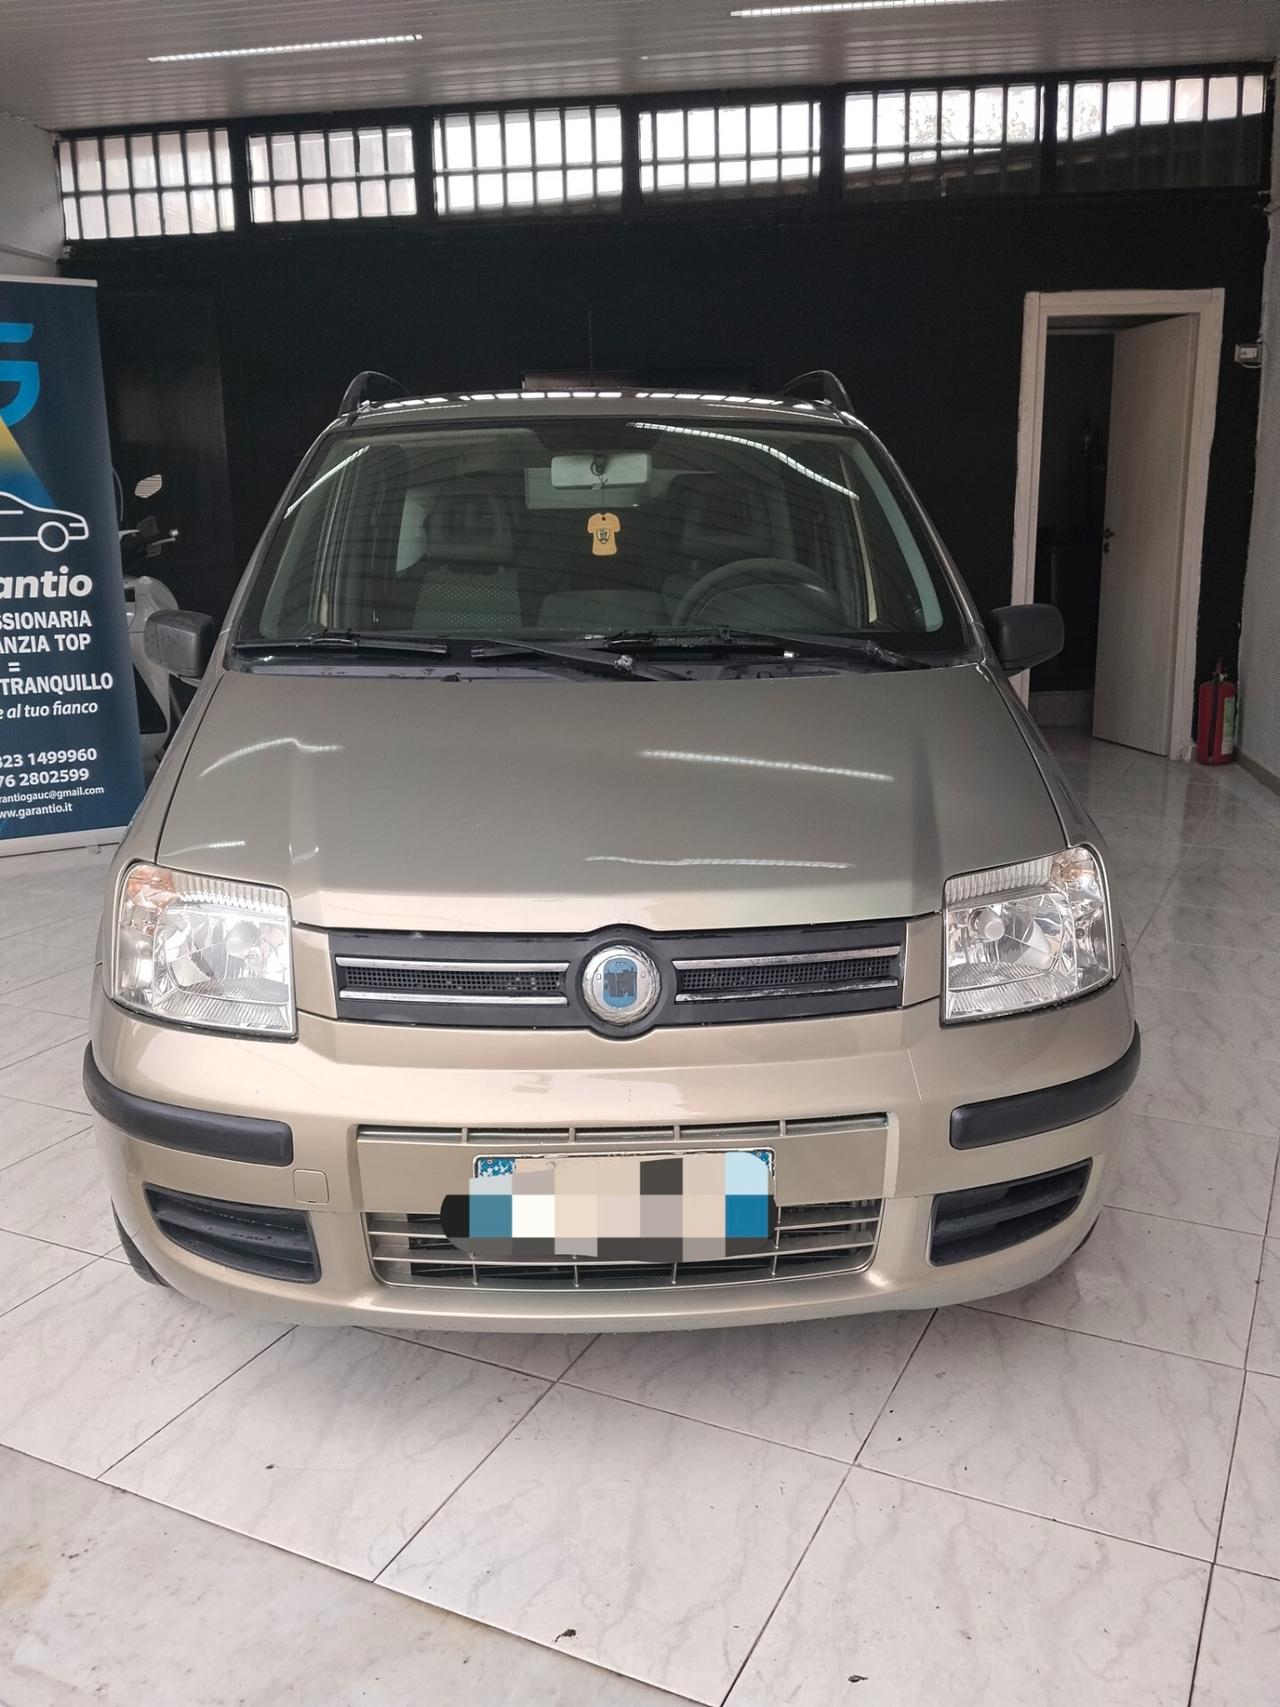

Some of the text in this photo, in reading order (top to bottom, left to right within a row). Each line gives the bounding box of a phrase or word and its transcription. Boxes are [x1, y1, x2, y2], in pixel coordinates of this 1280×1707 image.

[0, 610, 92, 630] SIONARIA
[54, 633, 91, 651] TOP
[0, 672, 113, 696] TRANQUILLO
[6, 703, 21, 719] al
[24, 704, 50, 718] tuo
[53, 701, 98, 716] fianco
[0, 748, 97, 769] 23 1499960
[19, 768, 90, 786] 2802599
